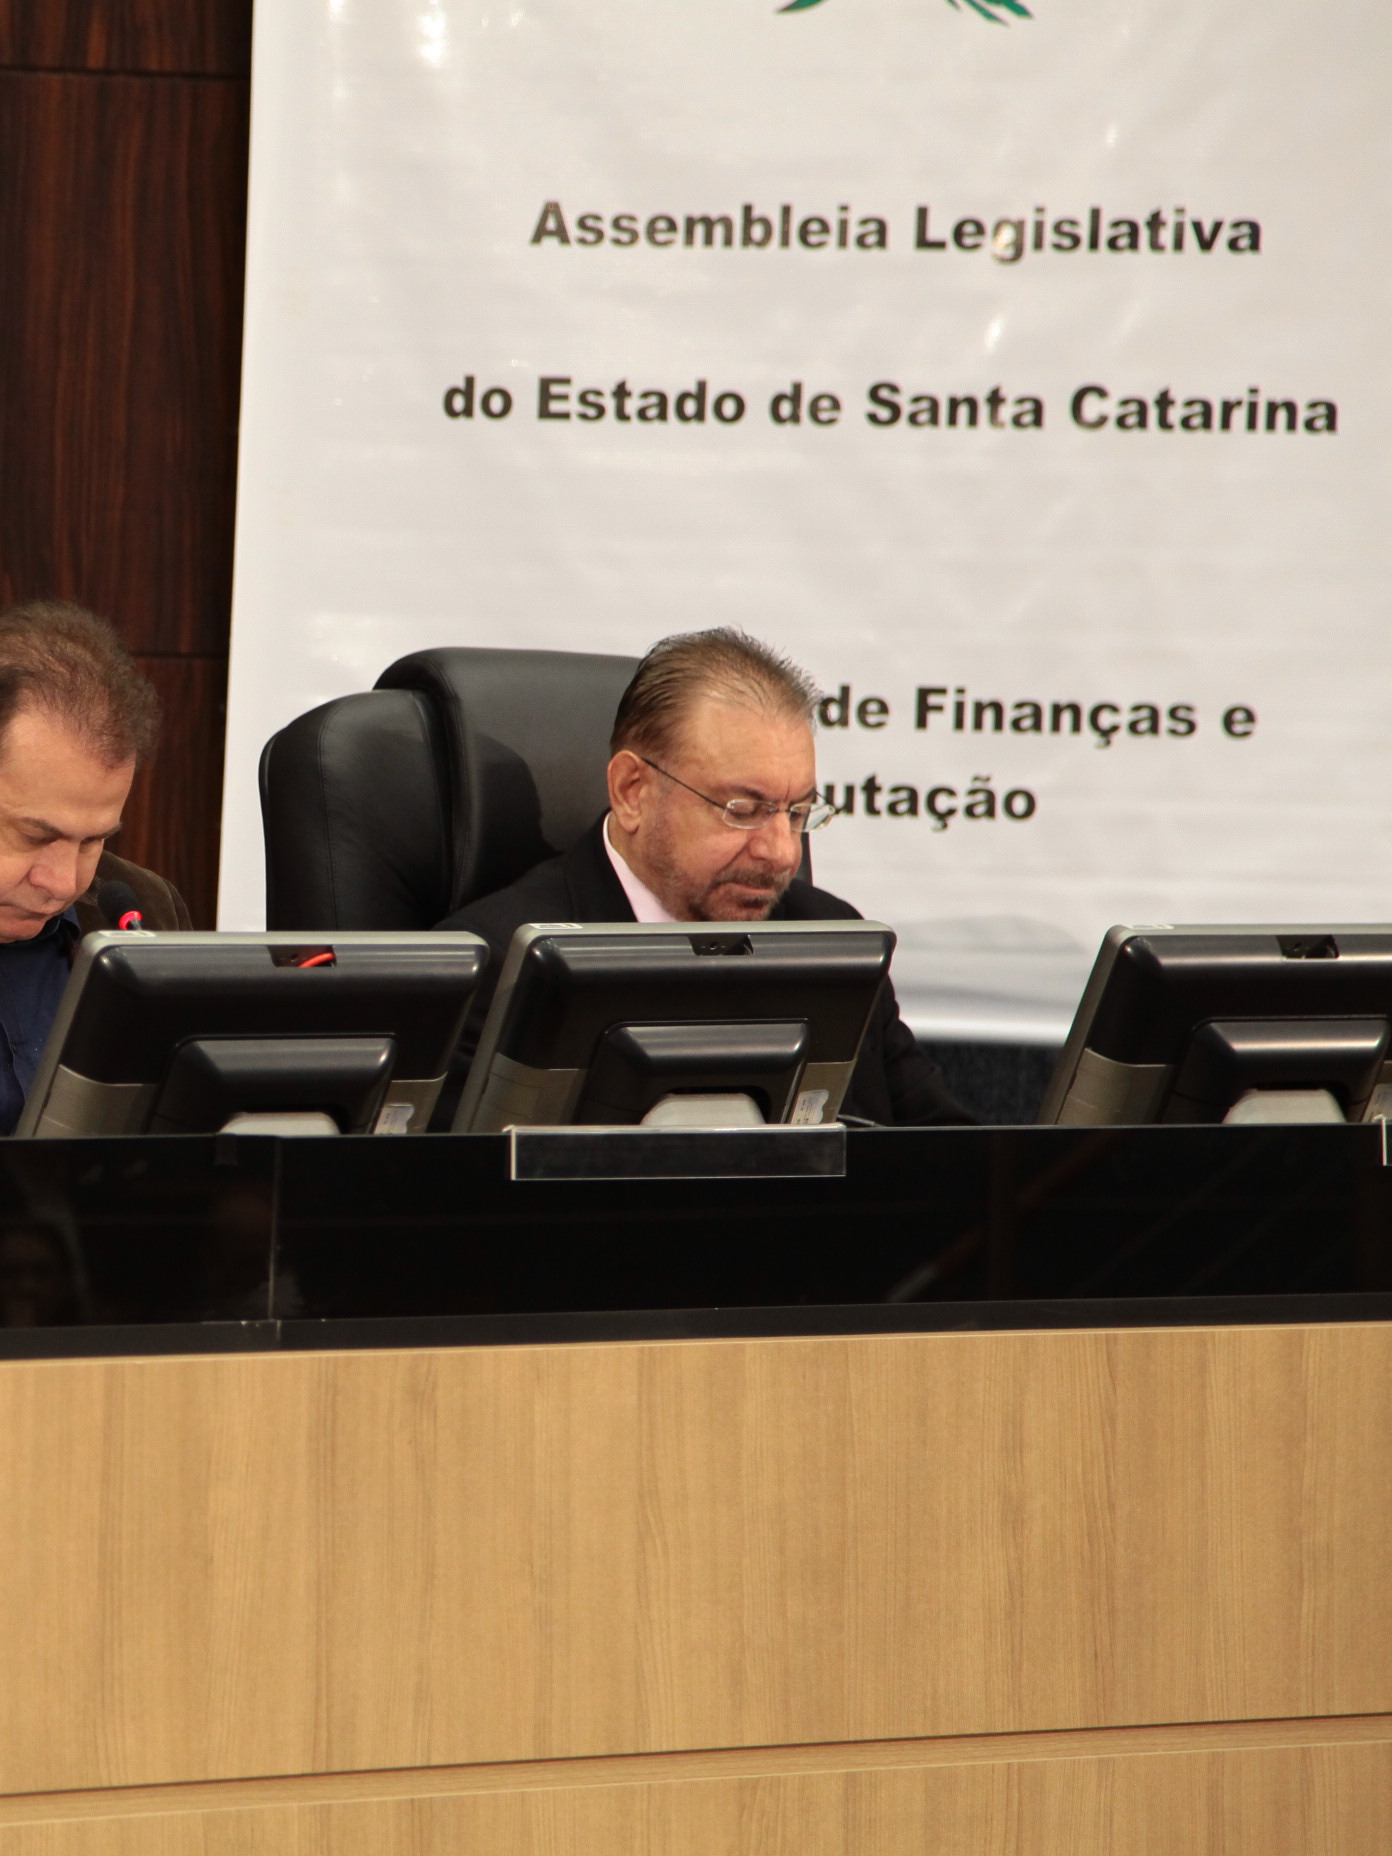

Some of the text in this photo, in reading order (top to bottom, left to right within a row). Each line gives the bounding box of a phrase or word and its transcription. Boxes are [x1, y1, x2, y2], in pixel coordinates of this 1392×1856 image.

[530, 201, 1262, 264] Assembleia Legislativa
[442, 375, 1340, 434] do Estado de Santa Catarina
[817, 684, 1257, 748] de Finanças e
